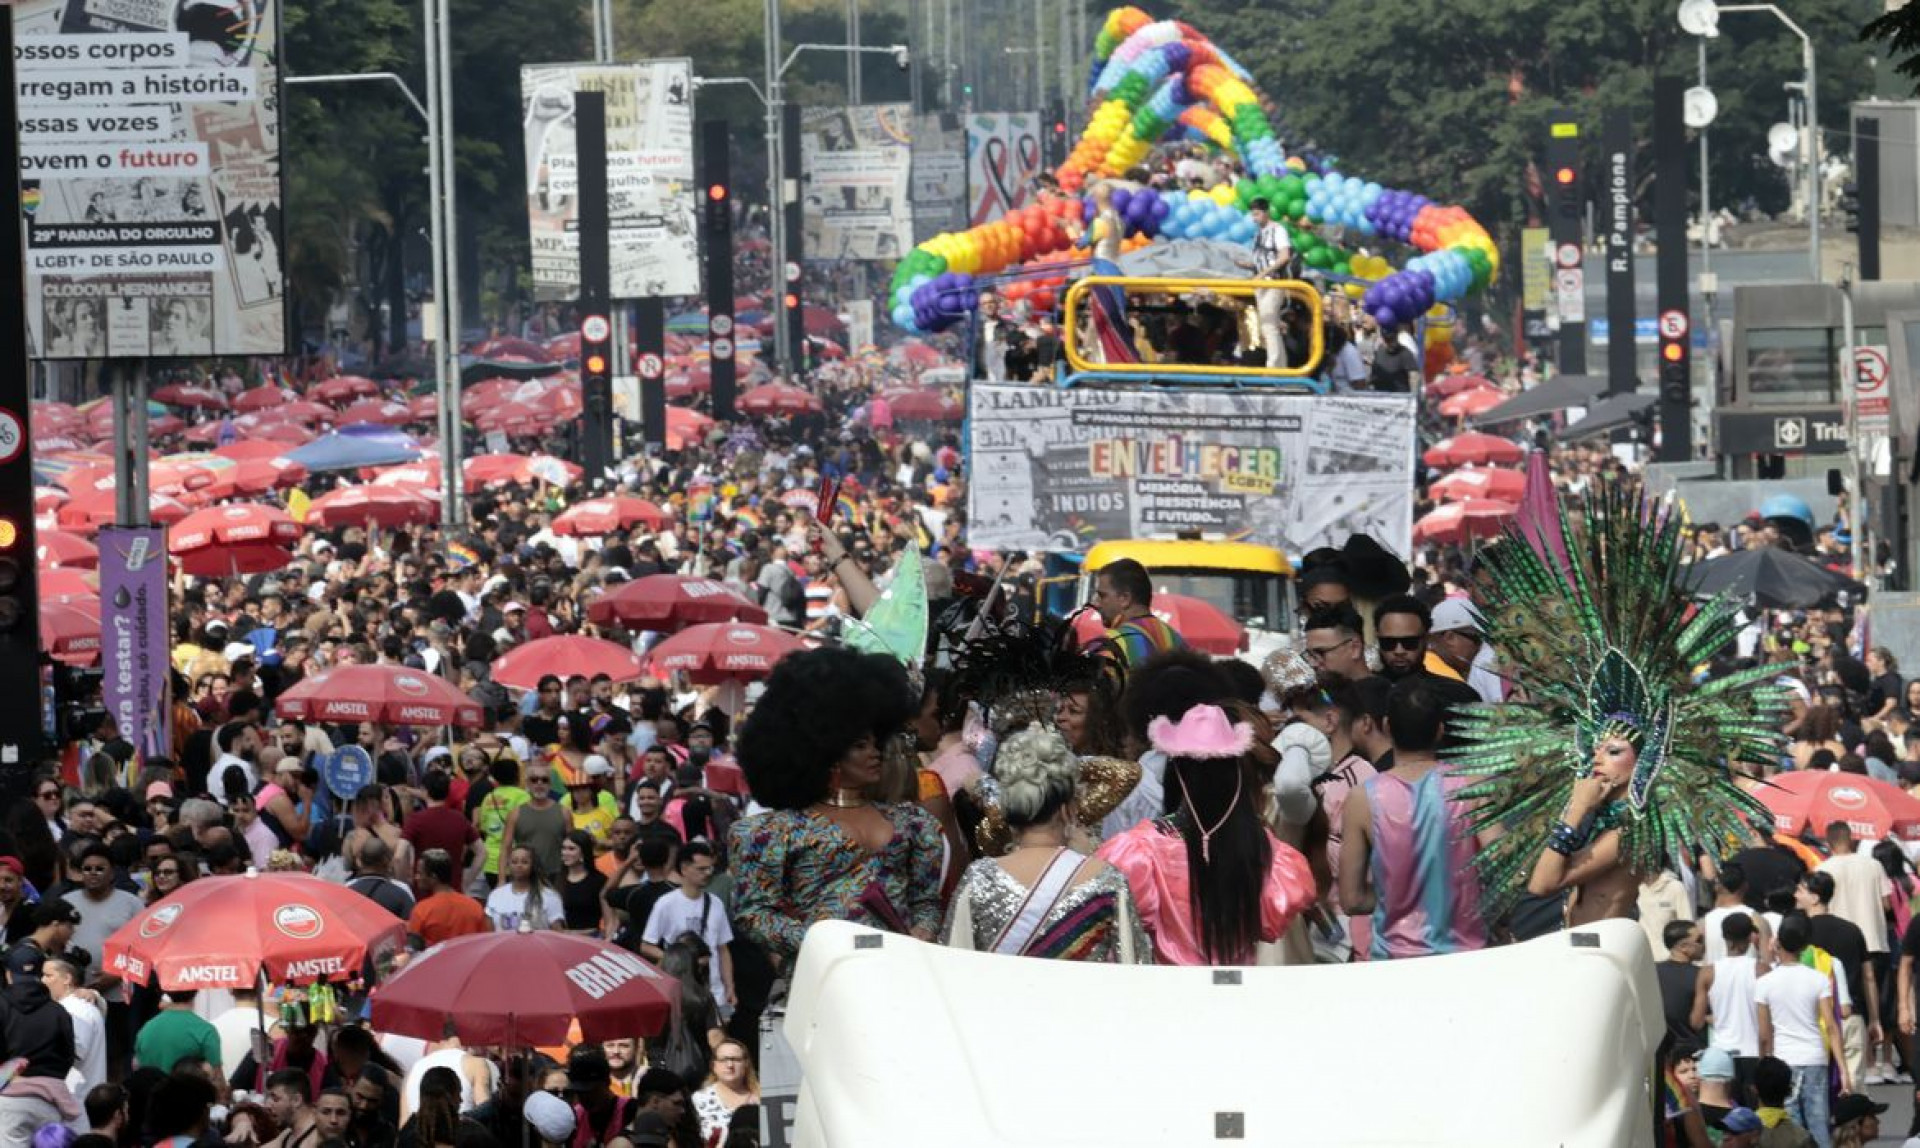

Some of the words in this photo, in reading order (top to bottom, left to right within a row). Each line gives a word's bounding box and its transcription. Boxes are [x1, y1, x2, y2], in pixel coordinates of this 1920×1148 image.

[14, 43, 79, 60] ossos
[88, 41, 176, 62] corpos
[20, 80, 113, 101] rregam
[122, 79, 136, 96] a
[144, 72, 249, 97] história,
[87, 115, 160, 132] vozes
[20, 153, 88, 170] ovem
[96, 152, 111, 169] o
[119, 148, 199, 169] futuro
[638, 155, 682, 165] futuro
[1610, 152, 1631, 246] Pamplona
[58, 228, 118, 242] PARADA
[119, 228, 142, 241] DO
[145, 226, 215, 241] ORGULHO
[34, 254, 85, 269] LGBT+
[90, 253, 114, 268] DE
[117, 249, 153, 267] SÃO
[157, 251, 215, 266] PAULO
[1611, 251, 1628, 272] R.
[43, 283, 117, 297] CLODOVIL
[1812, 421, 1850, 442] Tria
[1091, 435, 1282, 479] ENVELHECER
[1228, 475, 1272, 489] LGBT+
[113, 614, 133, 694] testar?
[136, 653, 149, 671] só
[726, 655, 767, 666] AMSTEL
[325, 702, 369, 716] AMSTEL
[400, 706, 441, 720] AMSTEL
[1847, 821, 1876, 837] STEL
[177, 964, 241, 984] AMSTEL
[285, 955, 347, 978] AMSTEL
